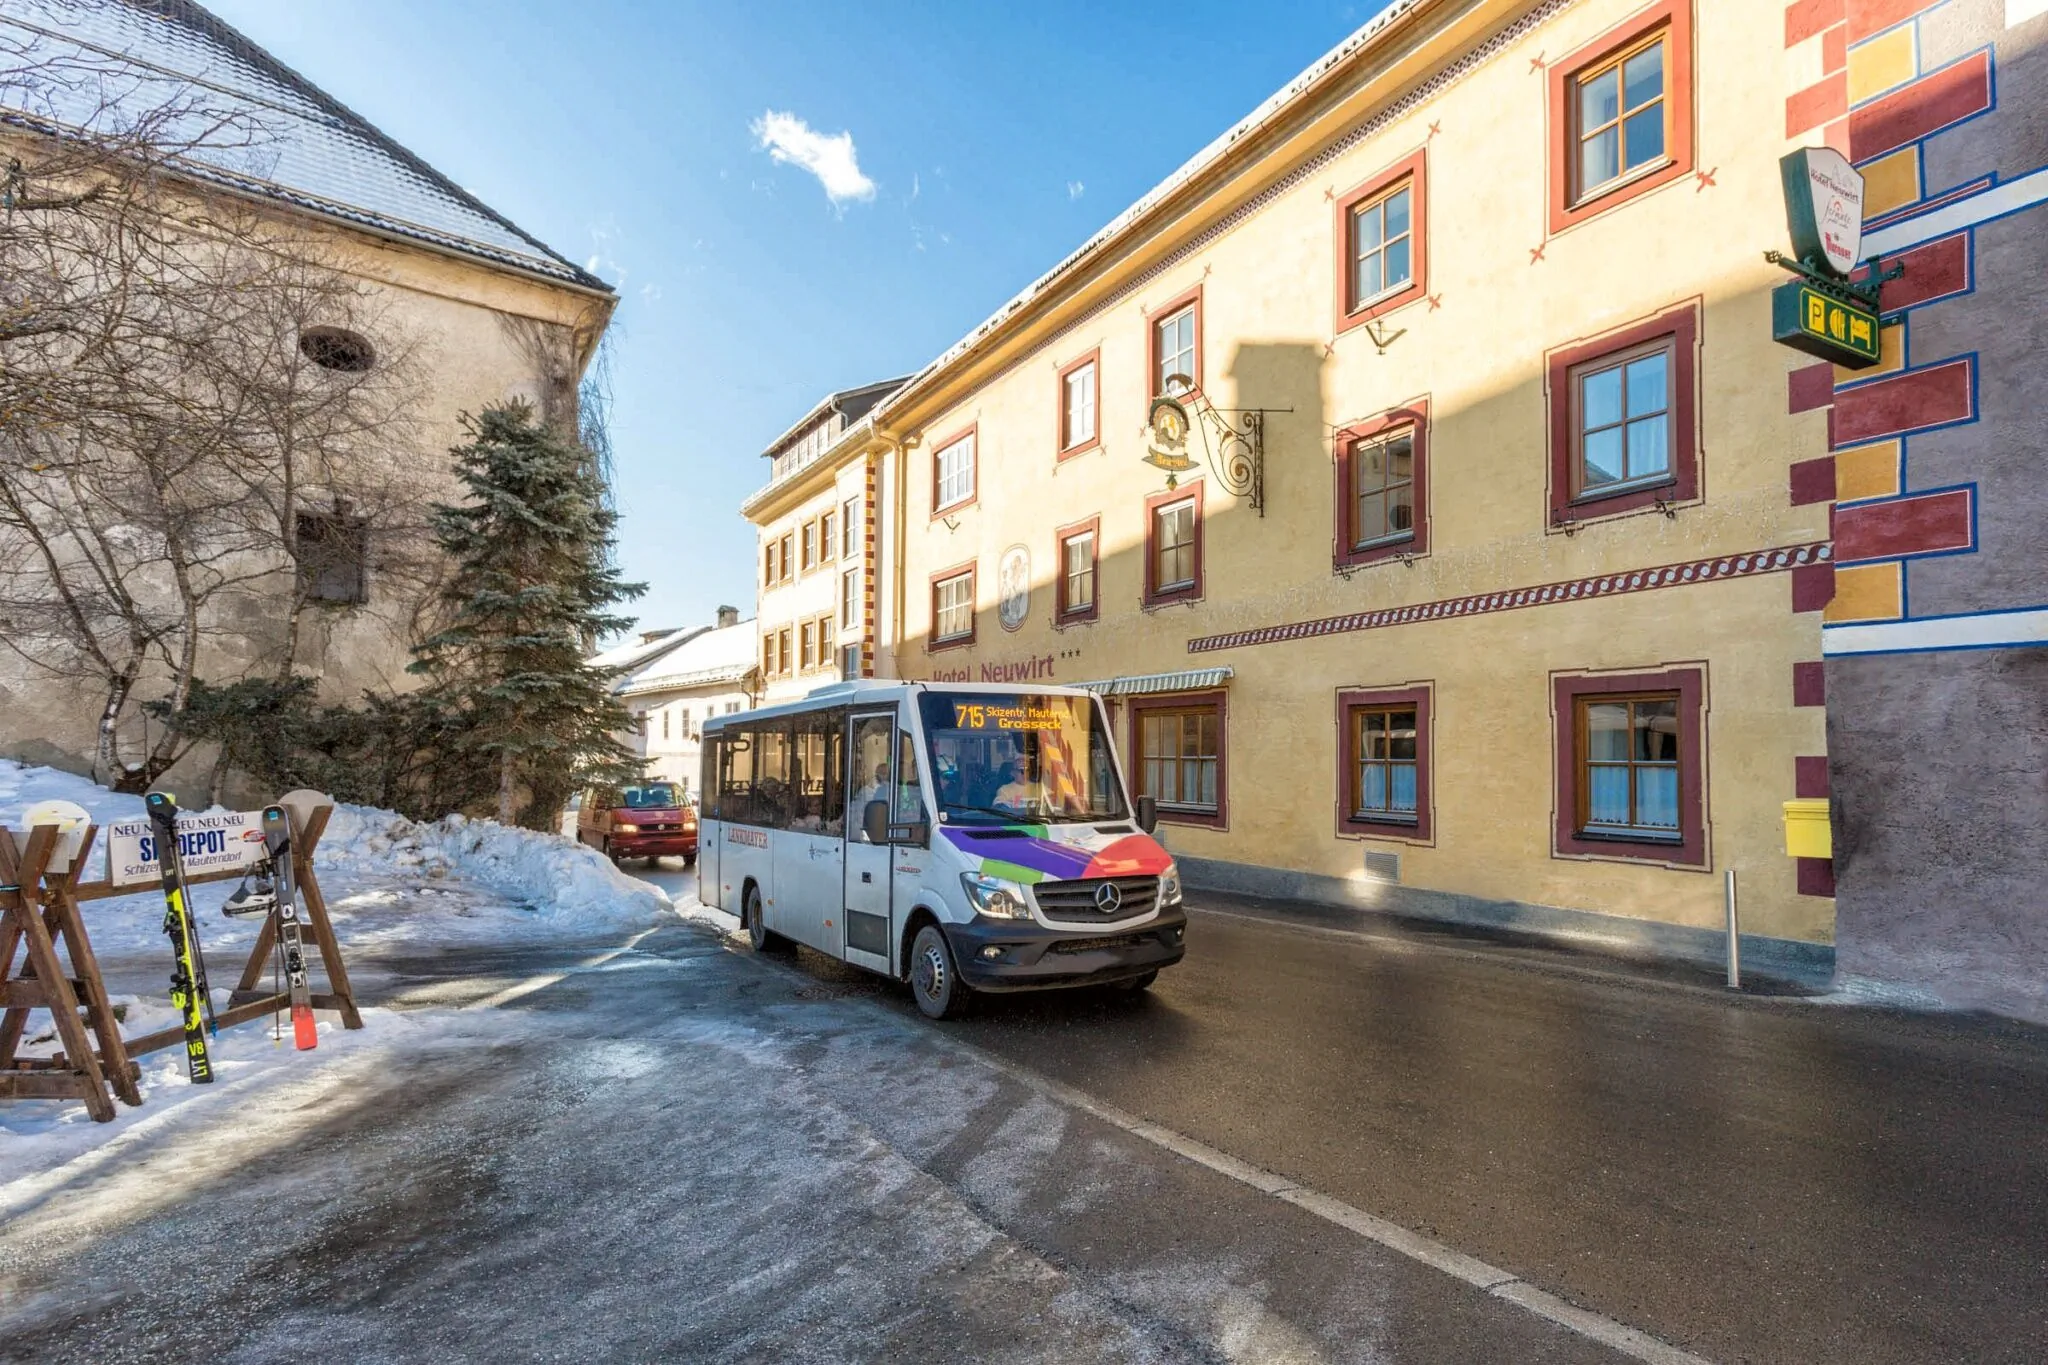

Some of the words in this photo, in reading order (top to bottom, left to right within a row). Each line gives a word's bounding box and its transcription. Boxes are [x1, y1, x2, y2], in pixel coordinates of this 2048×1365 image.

[1812, 303, 1822, 325] P
[933, 665, 971, 682] Hotel
[981, 654, 1055, 682] Neuwirt
[957, 704, 984, 728] 715
[999, 718, 1062, 729] Grosseck
[114, 824, 140, 836] NEU
[198, 817, 220, 828] NEU
[224, 815, 245, 826] NEU
